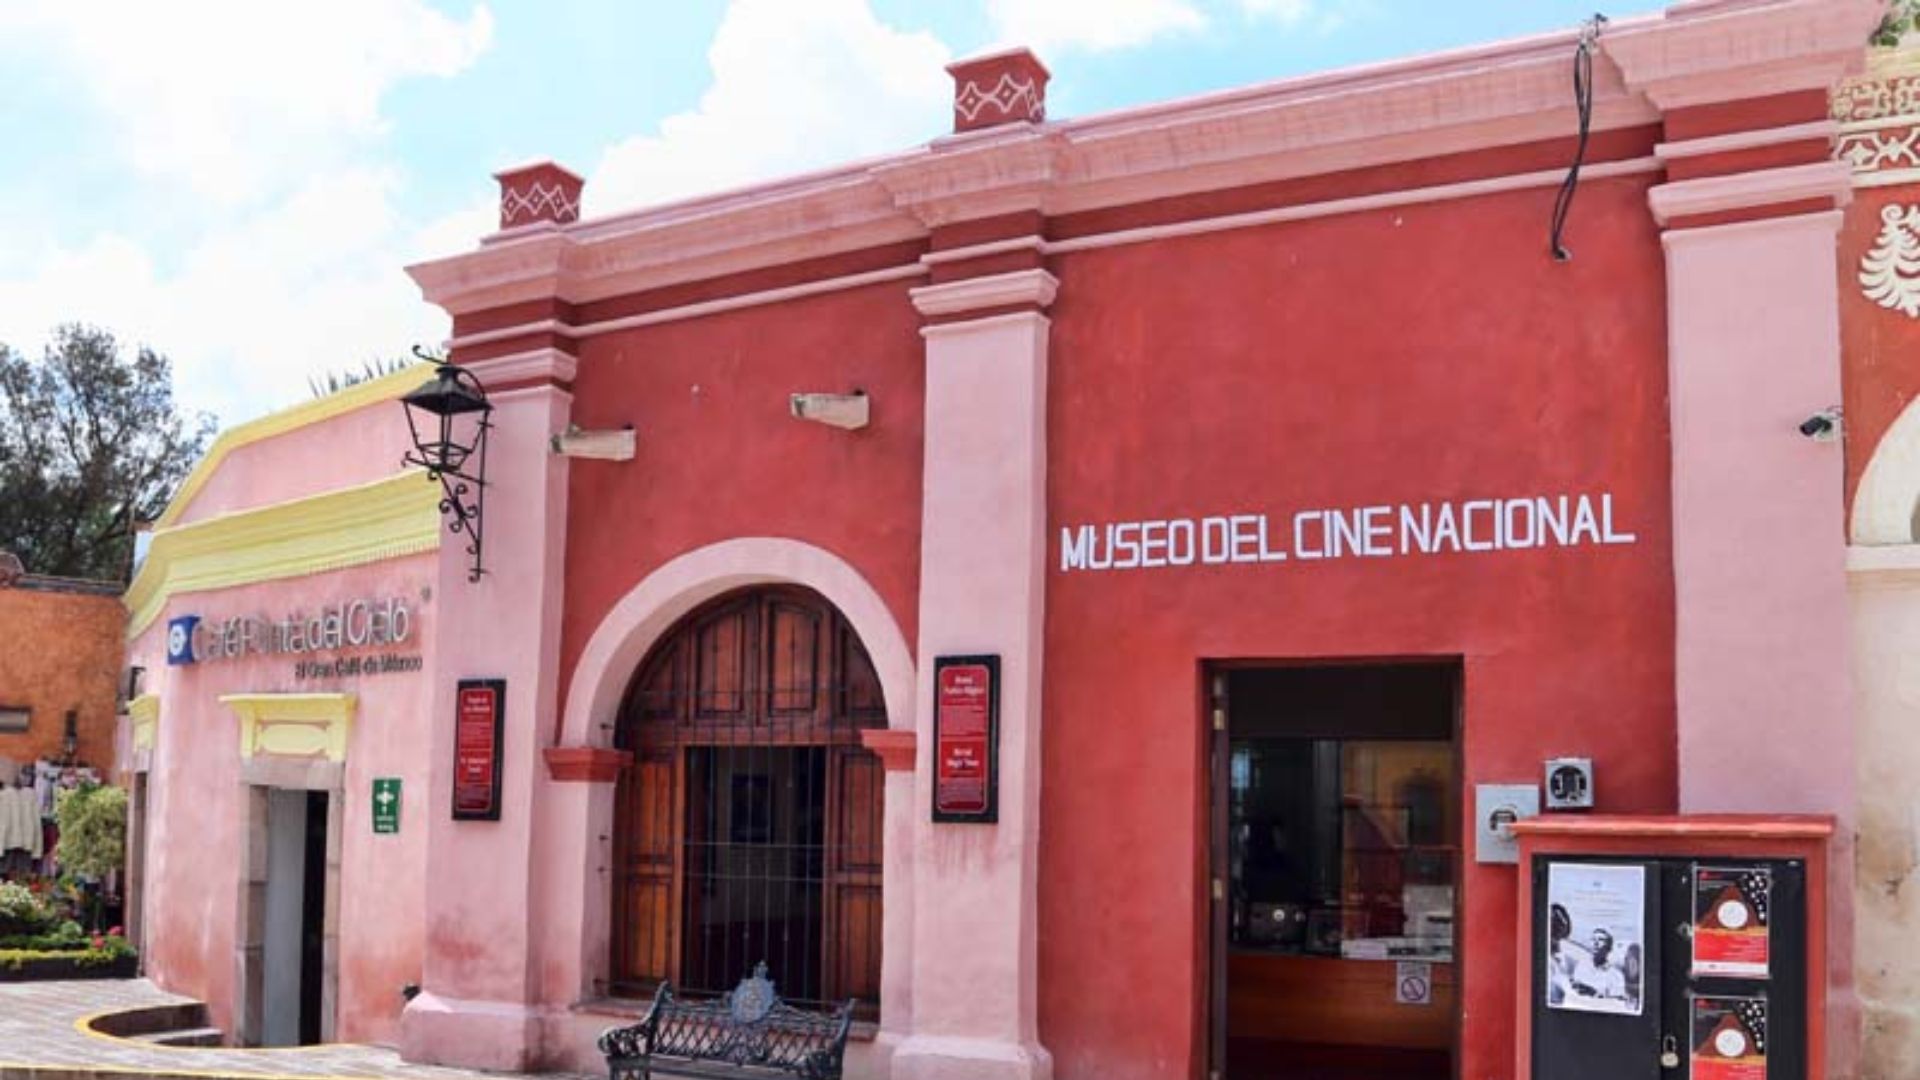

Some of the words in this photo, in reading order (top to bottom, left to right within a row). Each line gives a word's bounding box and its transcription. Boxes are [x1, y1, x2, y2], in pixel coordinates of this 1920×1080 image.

[1061, 519, 1195, 571] MUSEO
[1202, 513, 1287, 563] DEL
[1294, 505, 1393, 559] CINE
[1400, 493, 1636, 554] NACIONAL
[191, 615, 241, 661] Café
[308, 600, 343, 650] del
[347, 596, 410, 645] Cielo
